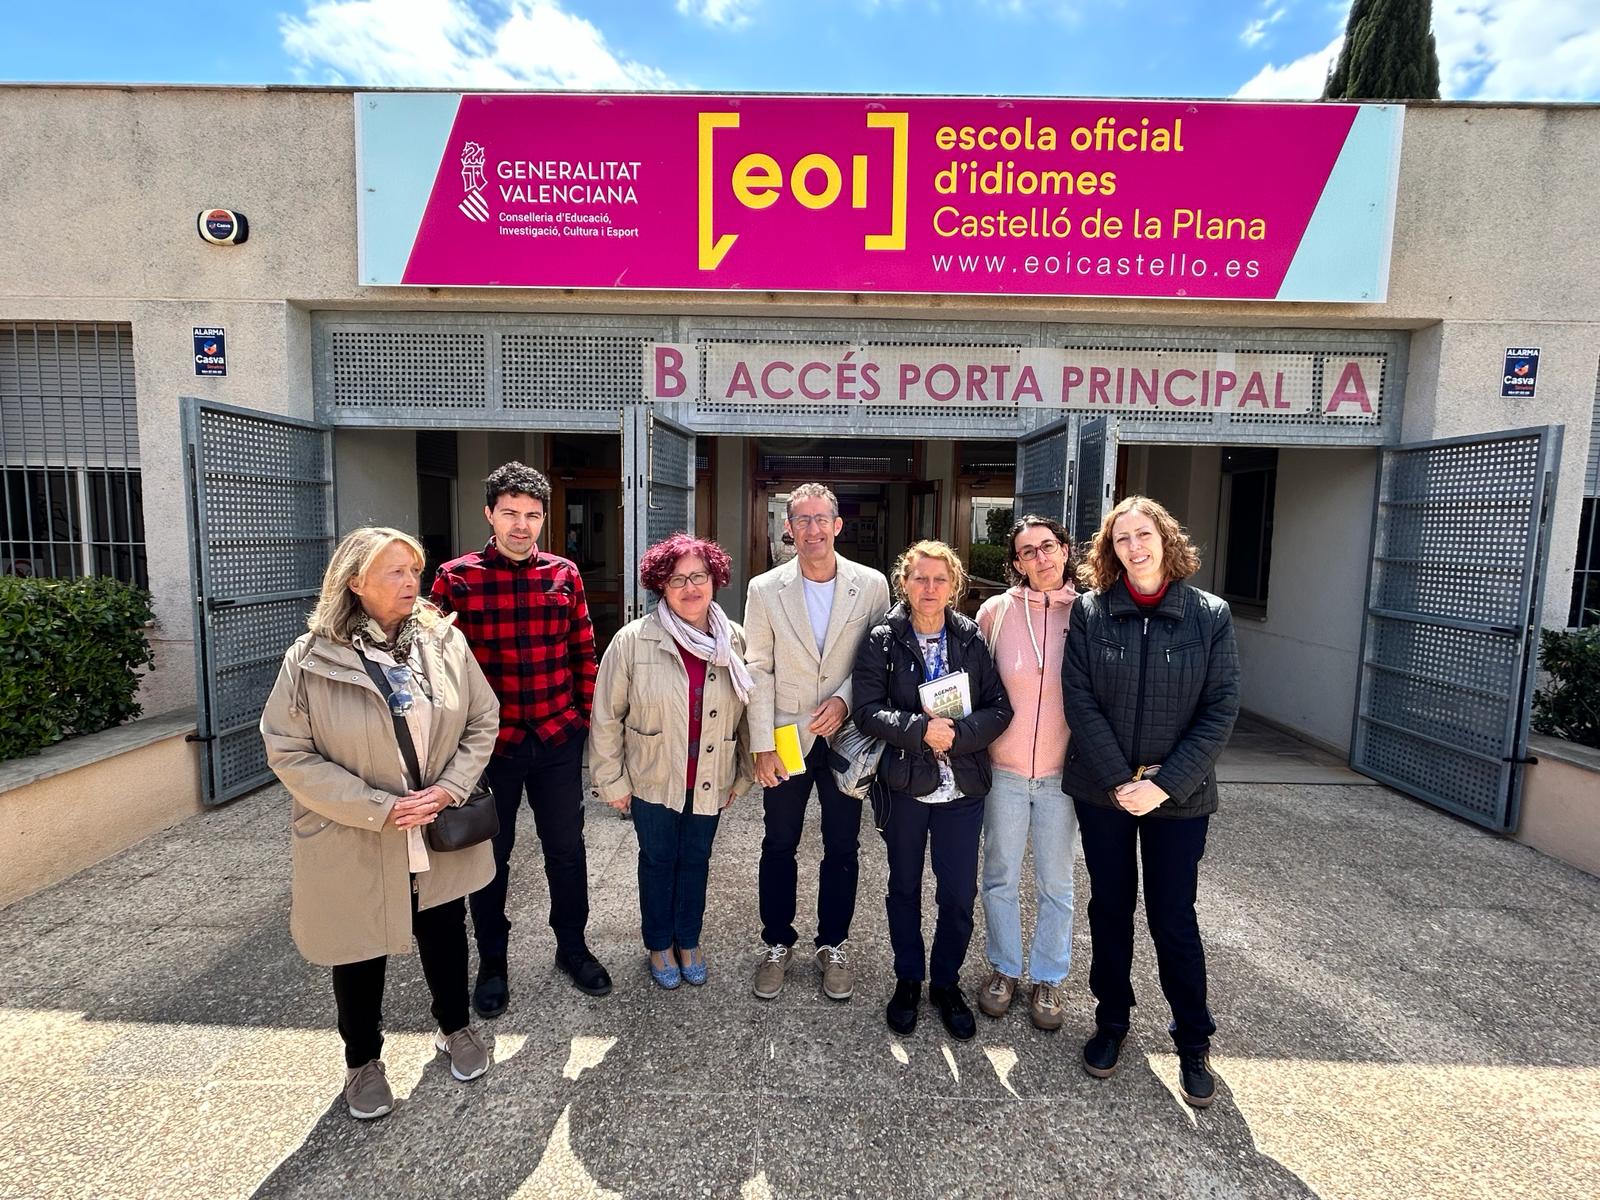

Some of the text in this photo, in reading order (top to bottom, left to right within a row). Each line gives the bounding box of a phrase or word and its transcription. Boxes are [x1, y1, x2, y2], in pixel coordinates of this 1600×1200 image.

[935, 117, 1184, 154] escola oficial
[496, 160, 642, 181] GENERALITAT
[498, 184, 639, 205] VALENCIANA
[498, 211, 612, 225] Conselleria d'Educació,
[932, 206, 1267, 242] Castelló de la Plana
[499, 225, 640, 240] Investigació, Cultura i Esport
[932, 252, 1260, 278] www.eoicastello.es
[194, 328, 224, 336] ALARMA
[195, 354, 224, 364] Casva
[655, 347, 1374, 416] B ACCÉS PORTA PRINCIPAL A
[1504, 375, 1534, 384] Casva
[934, 685, 957, 698] AGENDA
